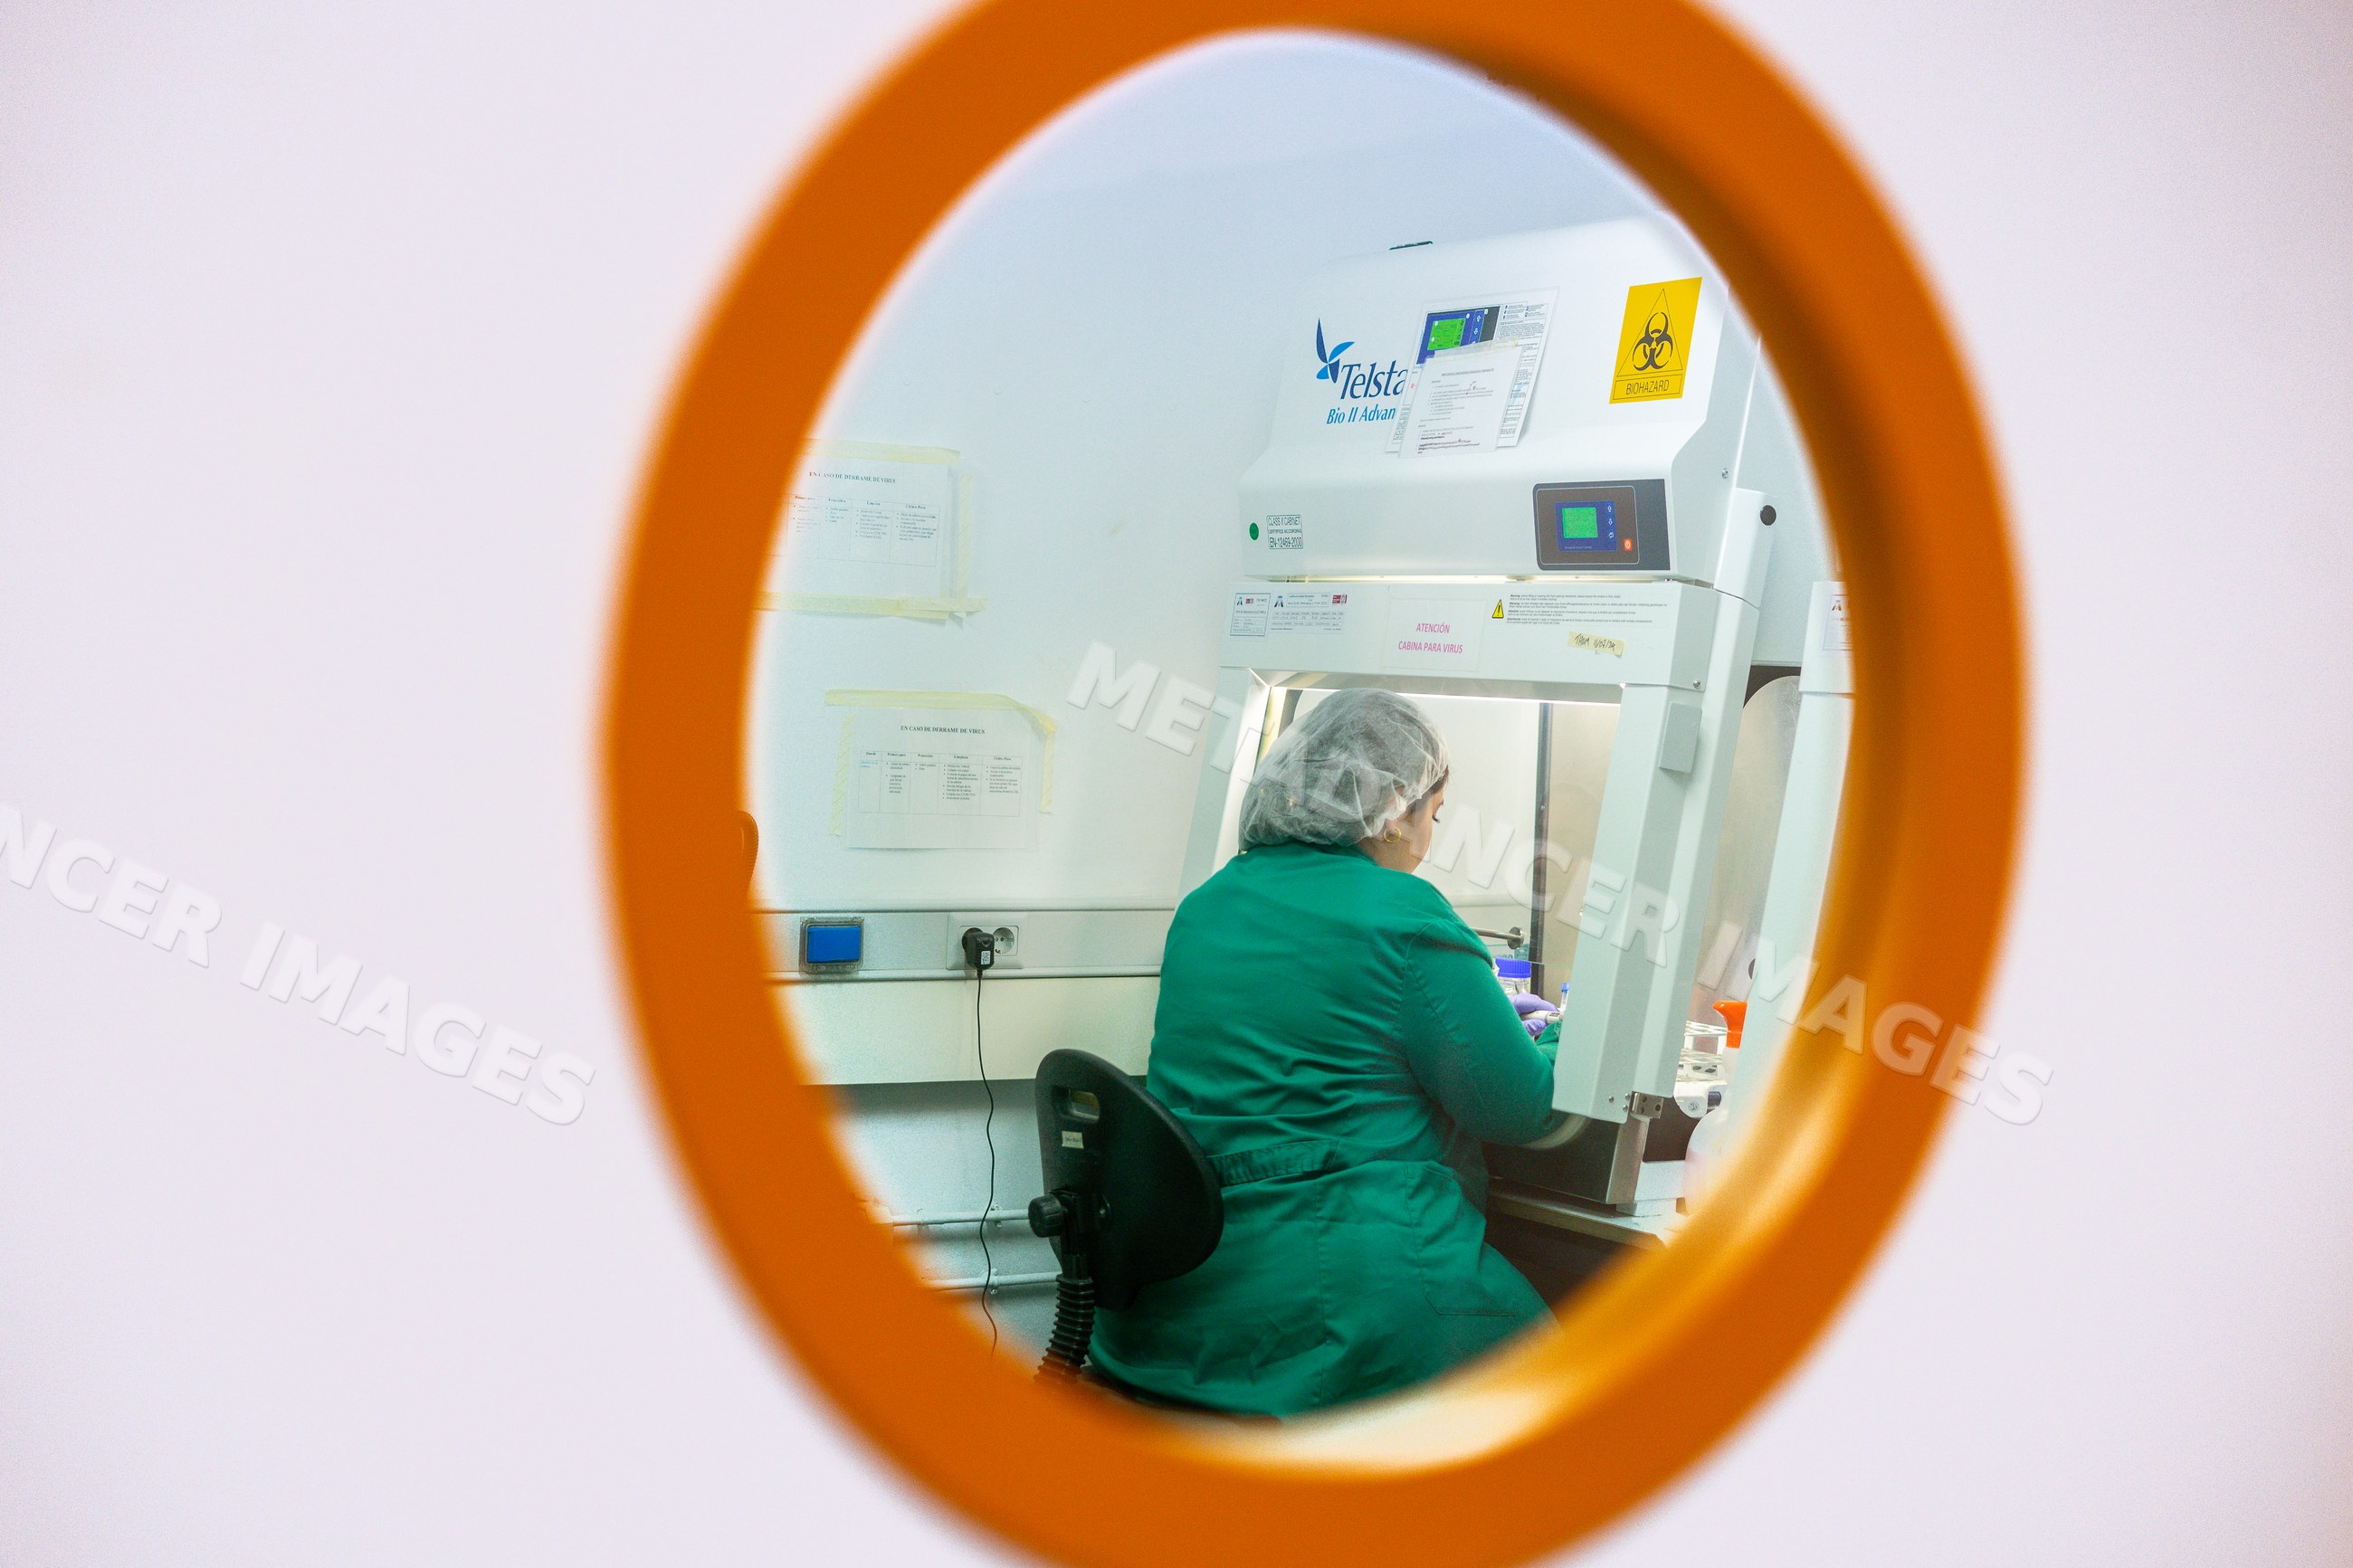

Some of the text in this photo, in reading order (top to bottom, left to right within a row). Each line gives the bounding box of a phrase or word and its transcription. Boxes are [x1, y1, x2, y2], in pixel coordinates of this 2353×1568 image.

[1340, 360, 1408, 399] Telsta
[1625, 379, 1669, 394] BIOHAZARD
[1326, 404, 1396, 424] Bio II Advan
[1415, 622, 1451, 633] ATENCIÓN
[1398, 641, 1463, 653] CABINA PARA VIRUS
